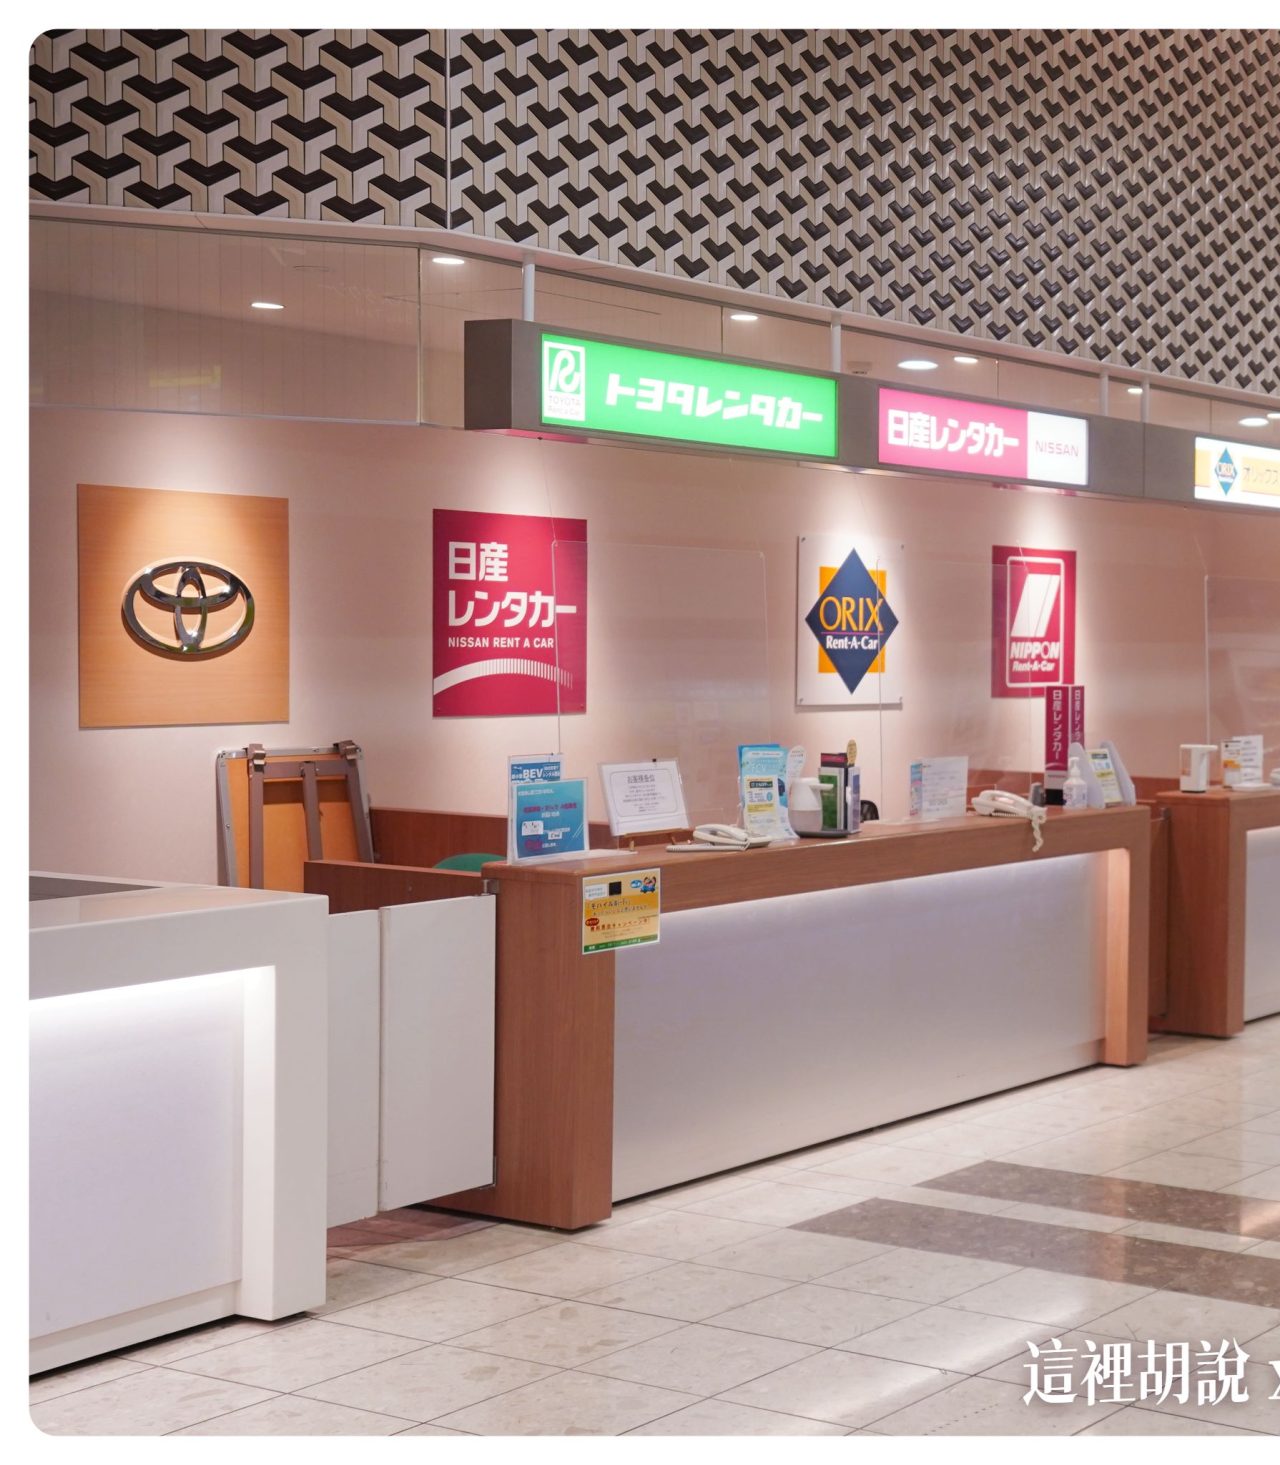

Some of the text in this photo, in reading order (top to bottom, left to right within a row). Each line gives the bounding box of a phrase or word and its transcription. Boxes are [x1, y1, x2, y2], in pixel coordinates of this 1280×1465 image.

[605, 373, 823, 430] トヨタレンタカー
[888, 408, 1019, 457] 日産レンタカー
[1035, 440, 1079, 457] NISSAN
[448, 541, 509, 582] 日産
[448, 590, 577, 628] レンタカー
[819, 596, 884, 631] ORIX
[448, 637, 554, 648] NISSAN RENT A CAR
[826, 635, 878, 650] Rent-A-Car
[1010, 641, 1060, 659] NIPPON
[1012, 660, 1055, 672] Rent-A-Car
[1052, 689, 1062, 760] 日産レンタカー
[522, 768, 544, 779] BEV
